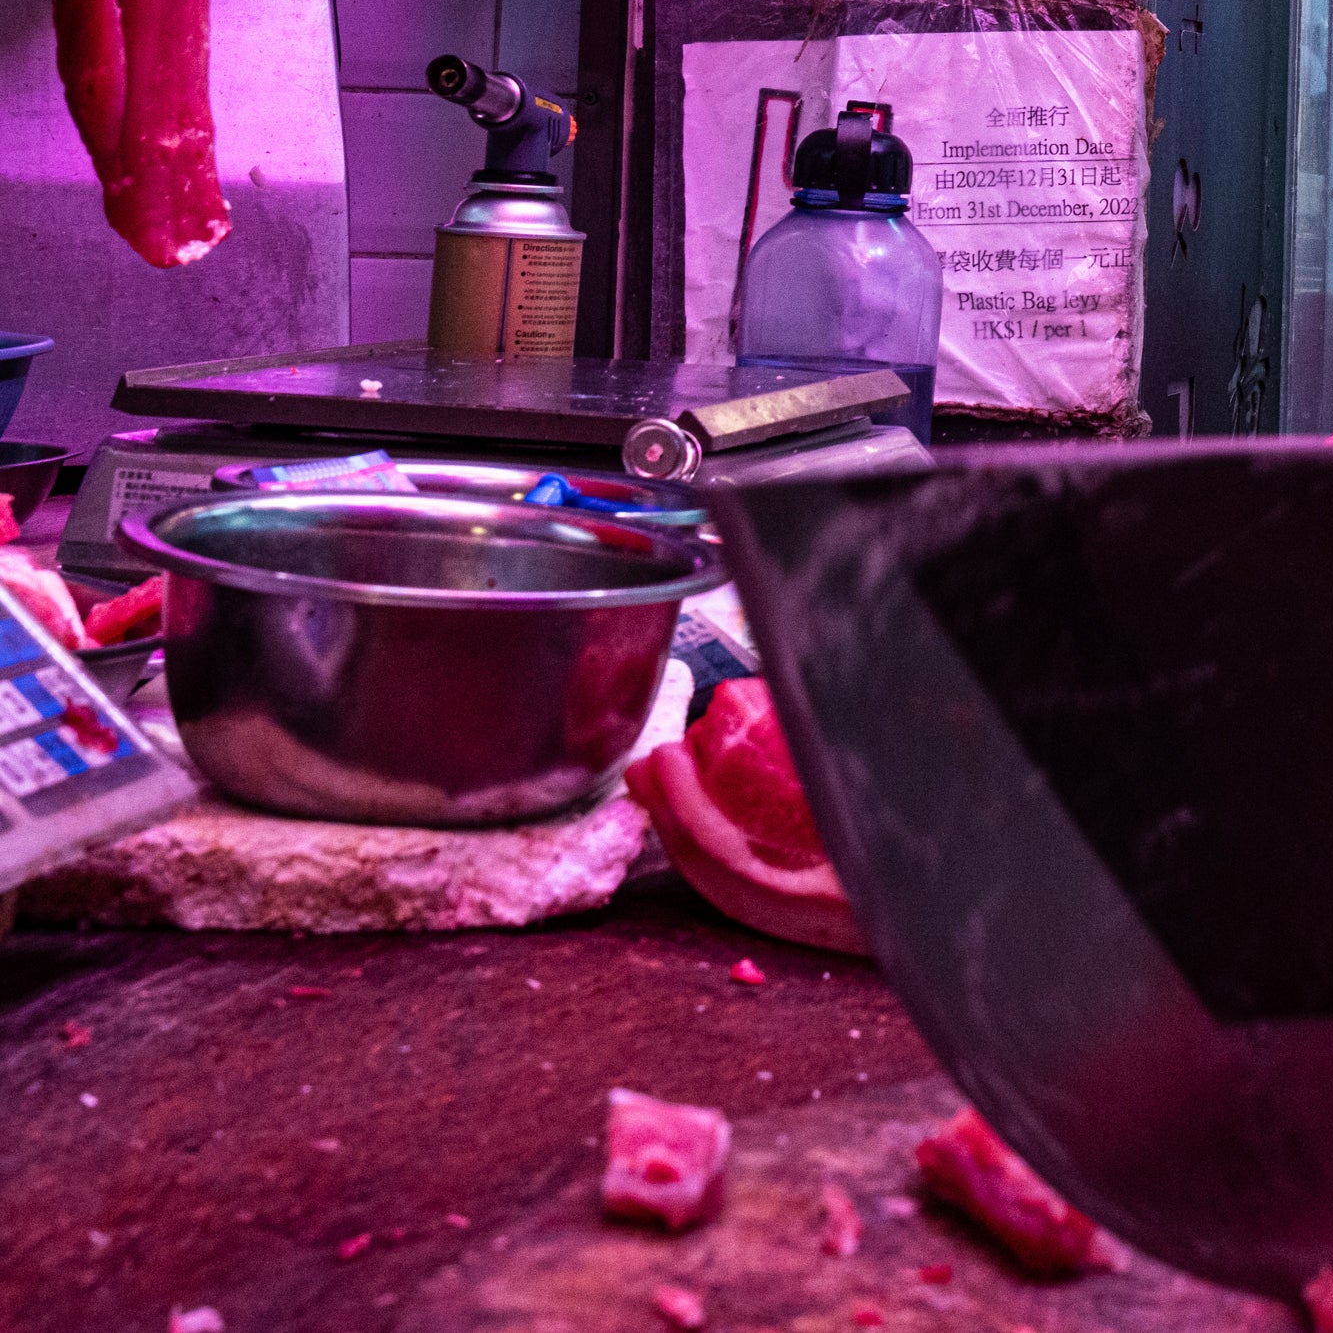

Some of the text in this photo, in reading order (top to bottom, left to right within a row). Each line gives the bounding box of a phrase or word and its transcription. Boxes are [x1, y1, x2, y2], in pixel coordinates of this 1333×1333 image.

[986, 106, 1070, 129] 全面推行
[941, 138, 1114, 161] Implementation Date
[935, 166, 1122, 191] 由2022年12月31日起
[917, 197, 1138, 221] From 31st December, 2022
[523, 243, 563, 253] Directions
[957, 290, 1102, 312] Plastic Bag levy
[515, 330, 548, 339] Caution
[972, 319, 1024, 341] HK$1
[1043, 323, 1073, 342] per
[1080, 319, 1088, 338] 1
